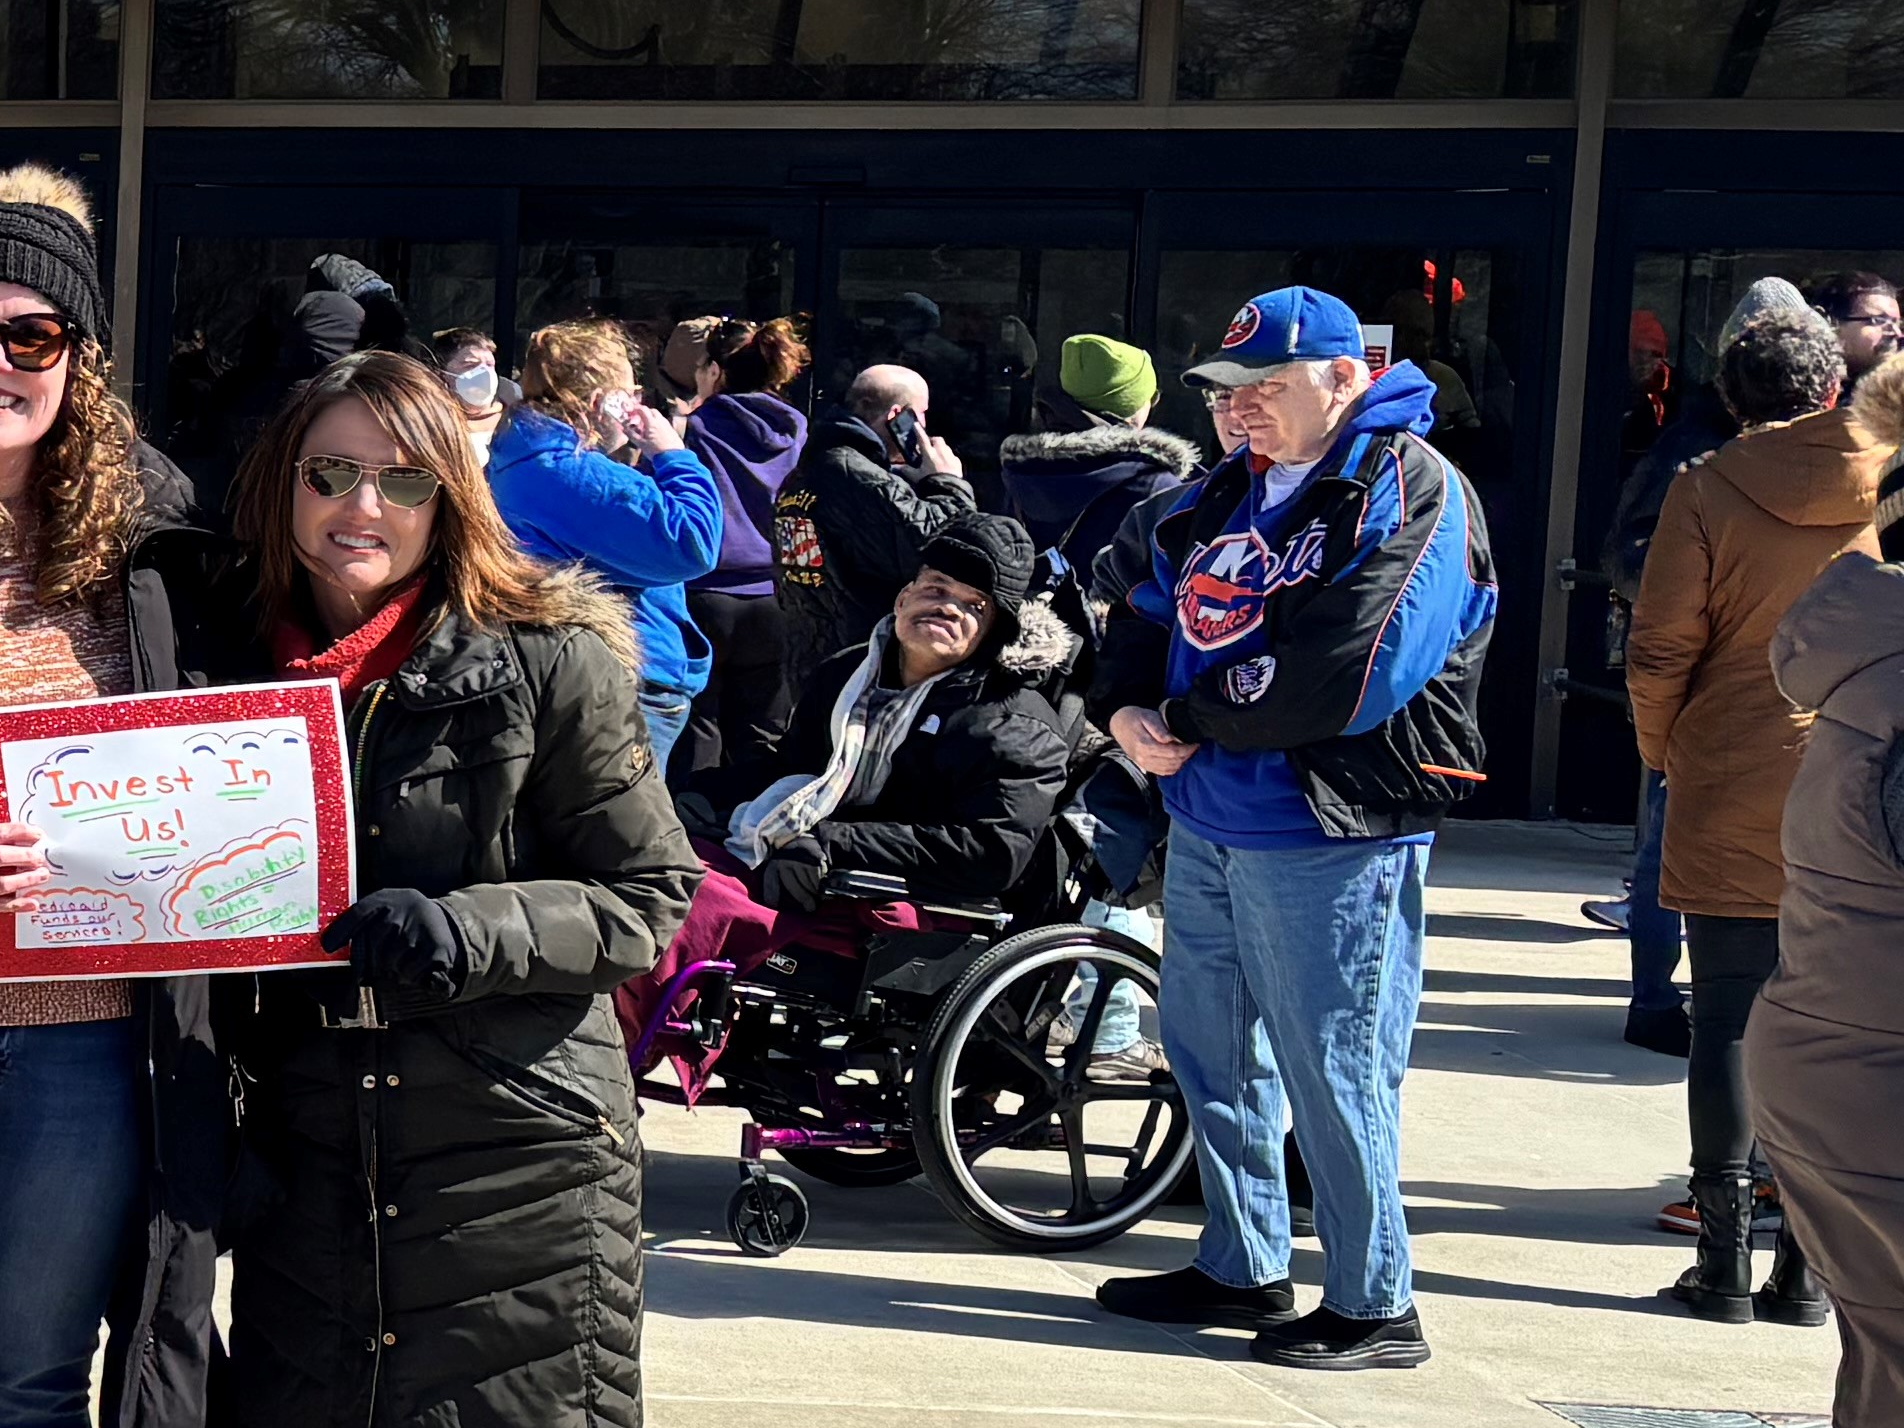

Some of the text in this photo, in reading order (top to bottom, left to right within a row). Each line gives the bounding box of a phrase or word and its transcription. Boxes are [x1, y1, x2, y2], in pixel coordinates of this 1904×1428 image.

[44, 759, 271, 807] Invest In
[122, 809, 190, 848] Us!
[39, 897, 108, 912] edicaid
